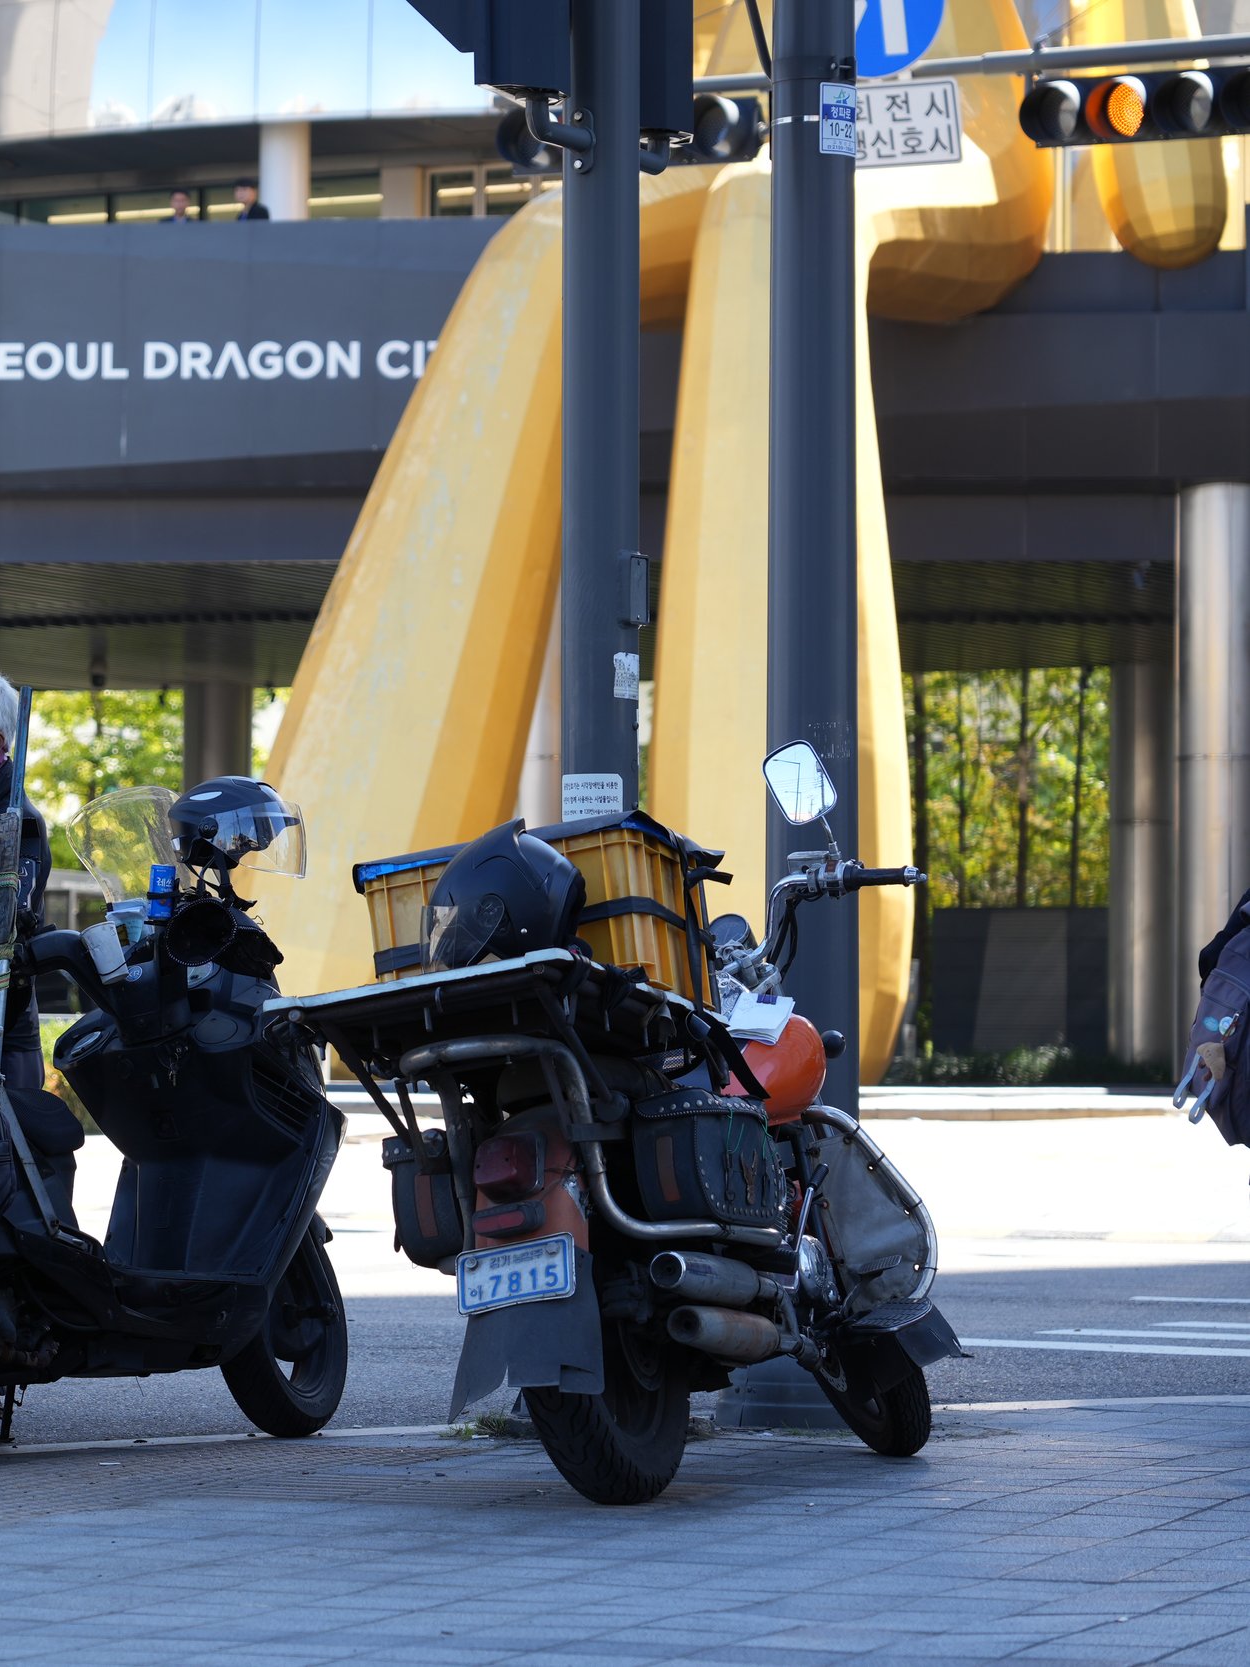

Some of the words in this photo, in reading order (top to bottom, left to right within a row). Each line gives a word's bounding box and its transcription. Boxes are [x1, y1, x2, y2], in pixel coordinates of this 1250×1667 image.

[830, 106, 852, 119] 청파로
[830, 122, 853, 139] 10-22
[143, 341, 360, 380] DRAGON
[489, 1264, 559, 1299] 7815
